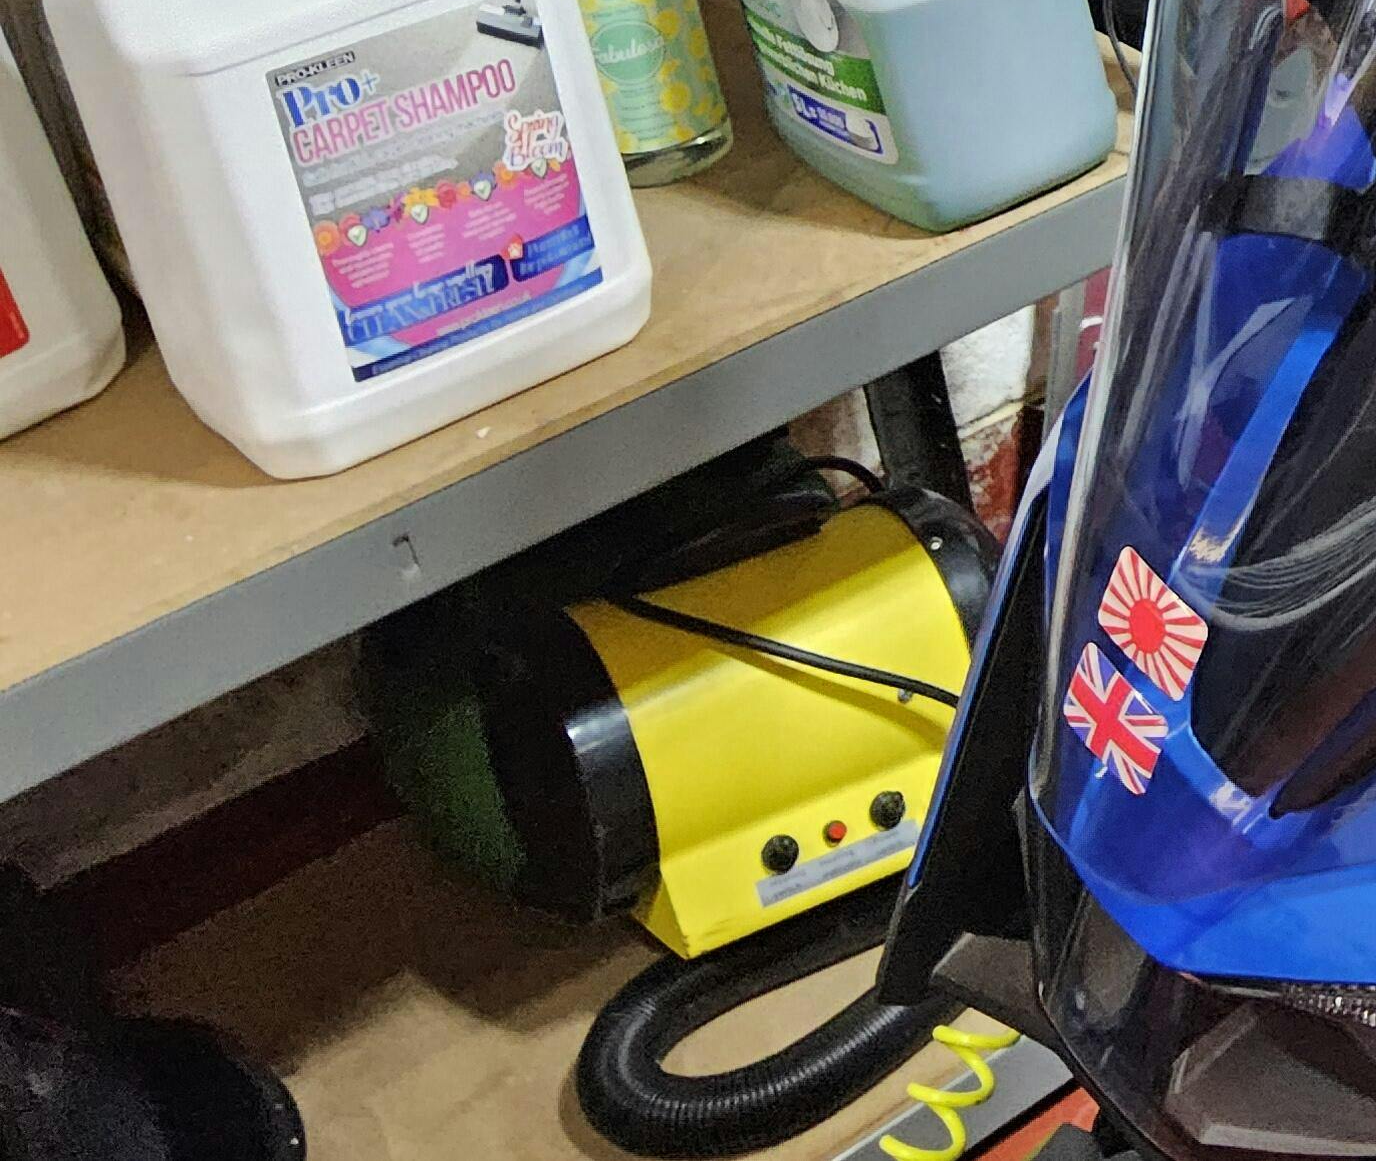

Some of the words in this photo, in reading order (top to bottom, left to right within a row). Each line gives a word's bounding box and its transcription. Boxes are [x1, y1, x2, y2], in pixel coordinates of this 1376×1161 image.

[277, 52, 354, 86] PRO-KLEEN
[292, 99, 391, 164] CARPET
[394, 58, 517, 130] SHAMPOO
[508, 111, 561, 147] Spring
